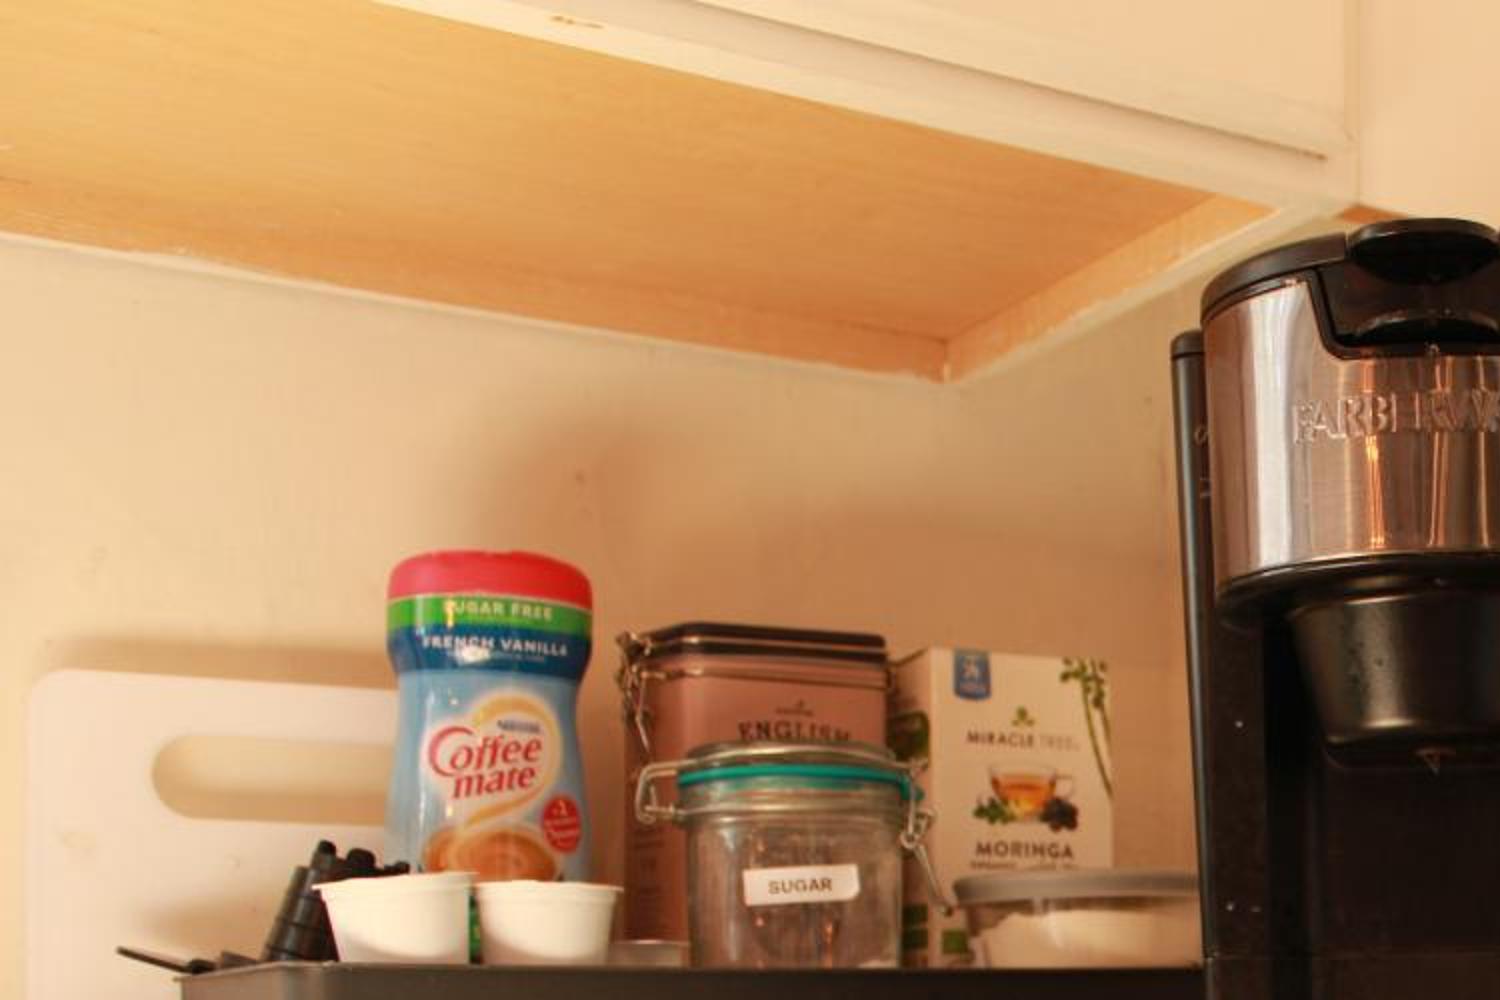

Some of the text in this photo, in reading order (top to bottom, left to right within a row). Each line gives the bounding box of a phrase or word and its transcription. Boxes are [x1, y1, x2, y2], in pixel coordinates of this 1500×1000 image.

[445, 600, 552, 622] SUGAR FREE
[421, 634, 496, 652] FRENCH
[966, 729, 1034, 749] MIRACLE
[429, 725, 542, 777] Coffee
[453, 766, 535, 799] mate
[976, 840, 1075, 859] MORINGA
[767, 876, 833, 896] SUGAR
